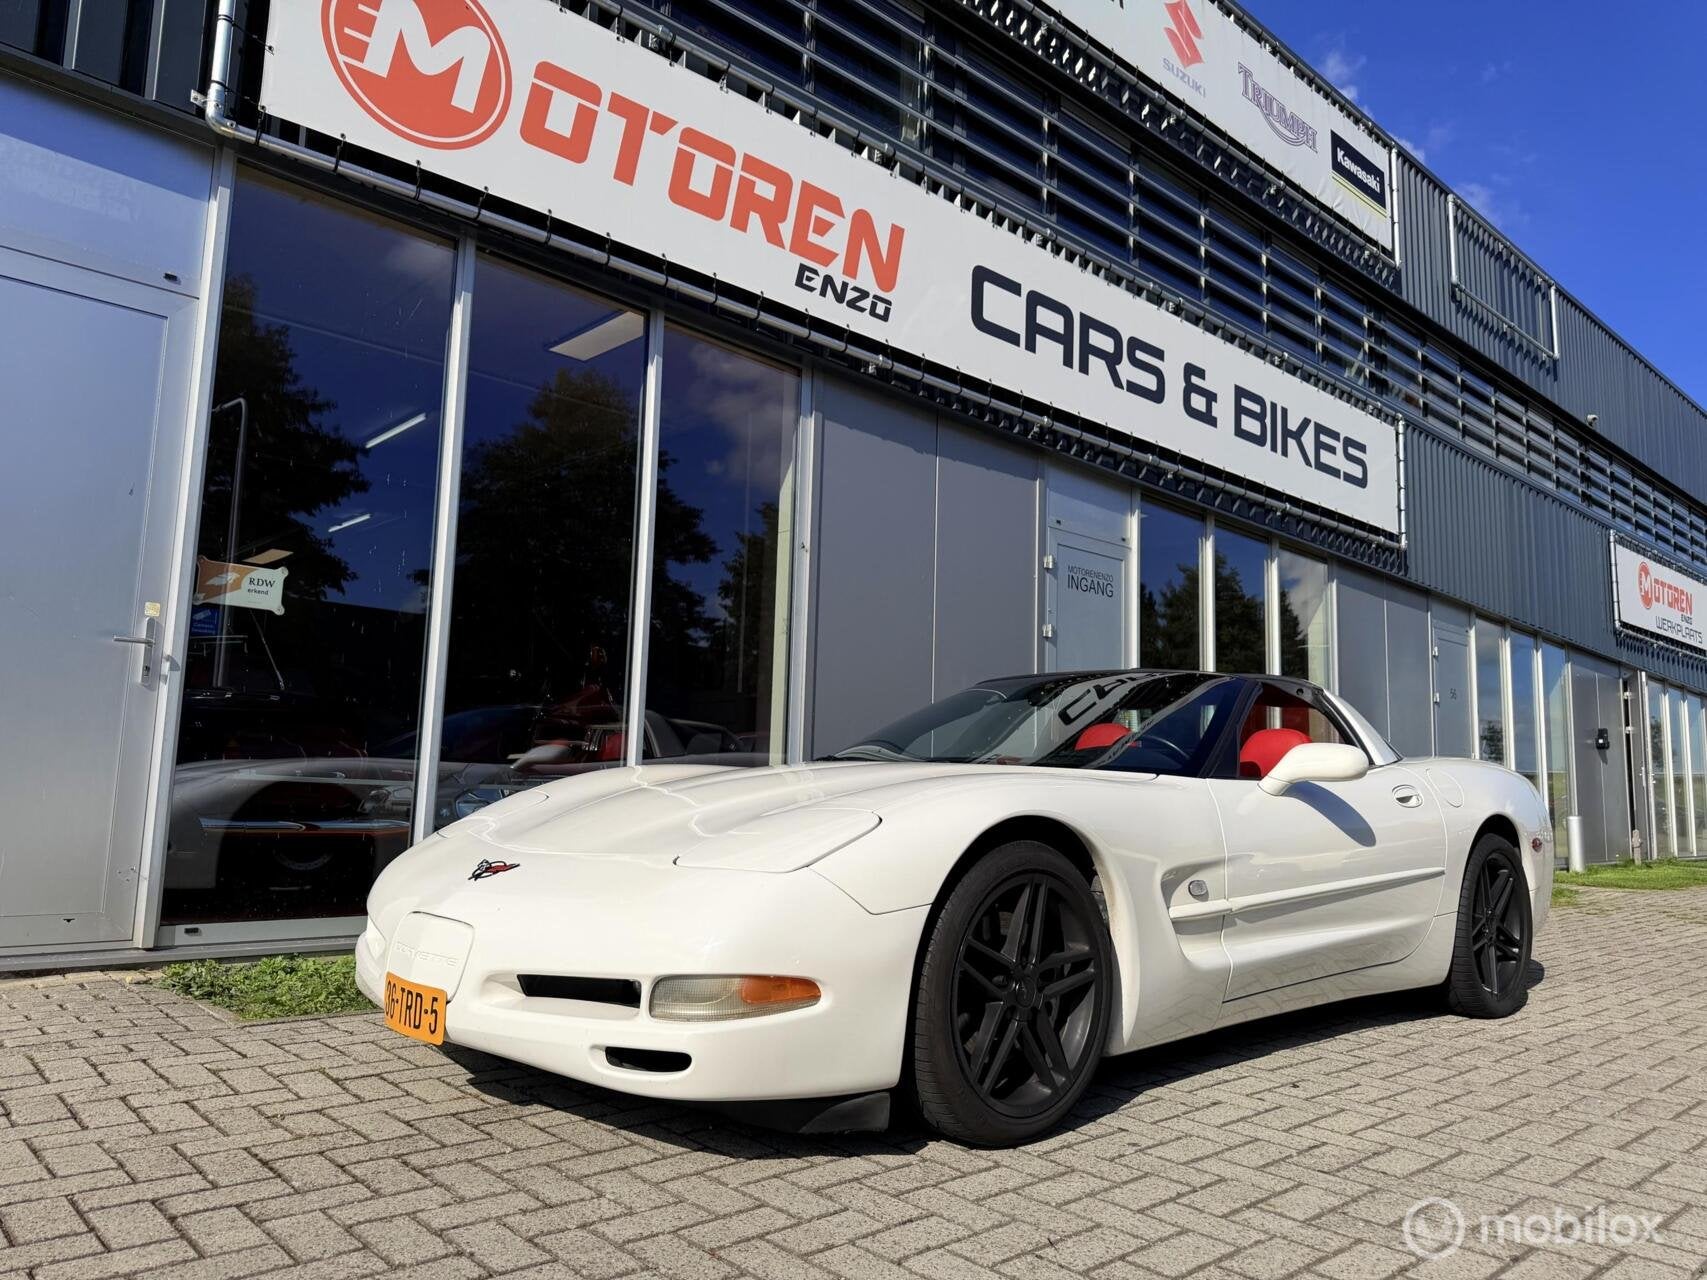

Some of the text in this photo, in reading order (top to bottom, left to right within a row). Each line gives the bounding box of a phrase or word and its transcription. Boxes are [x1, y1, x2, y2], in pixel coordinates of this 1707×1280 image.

[1162, 57, 1206, 99] SUZUKI
[1238, 61, 1318, 153] TRIUMPH
[1336, 147, 1380, 194] Kawasaki
[794, 262, 892, 322] ENZO
[971, 265, 1369, 489] CARS & BIKES
[247, 588, 269, 596] erkend
[248, 577, 276, 588] RDW
[1067, 574, 1114, 598] INGANG
